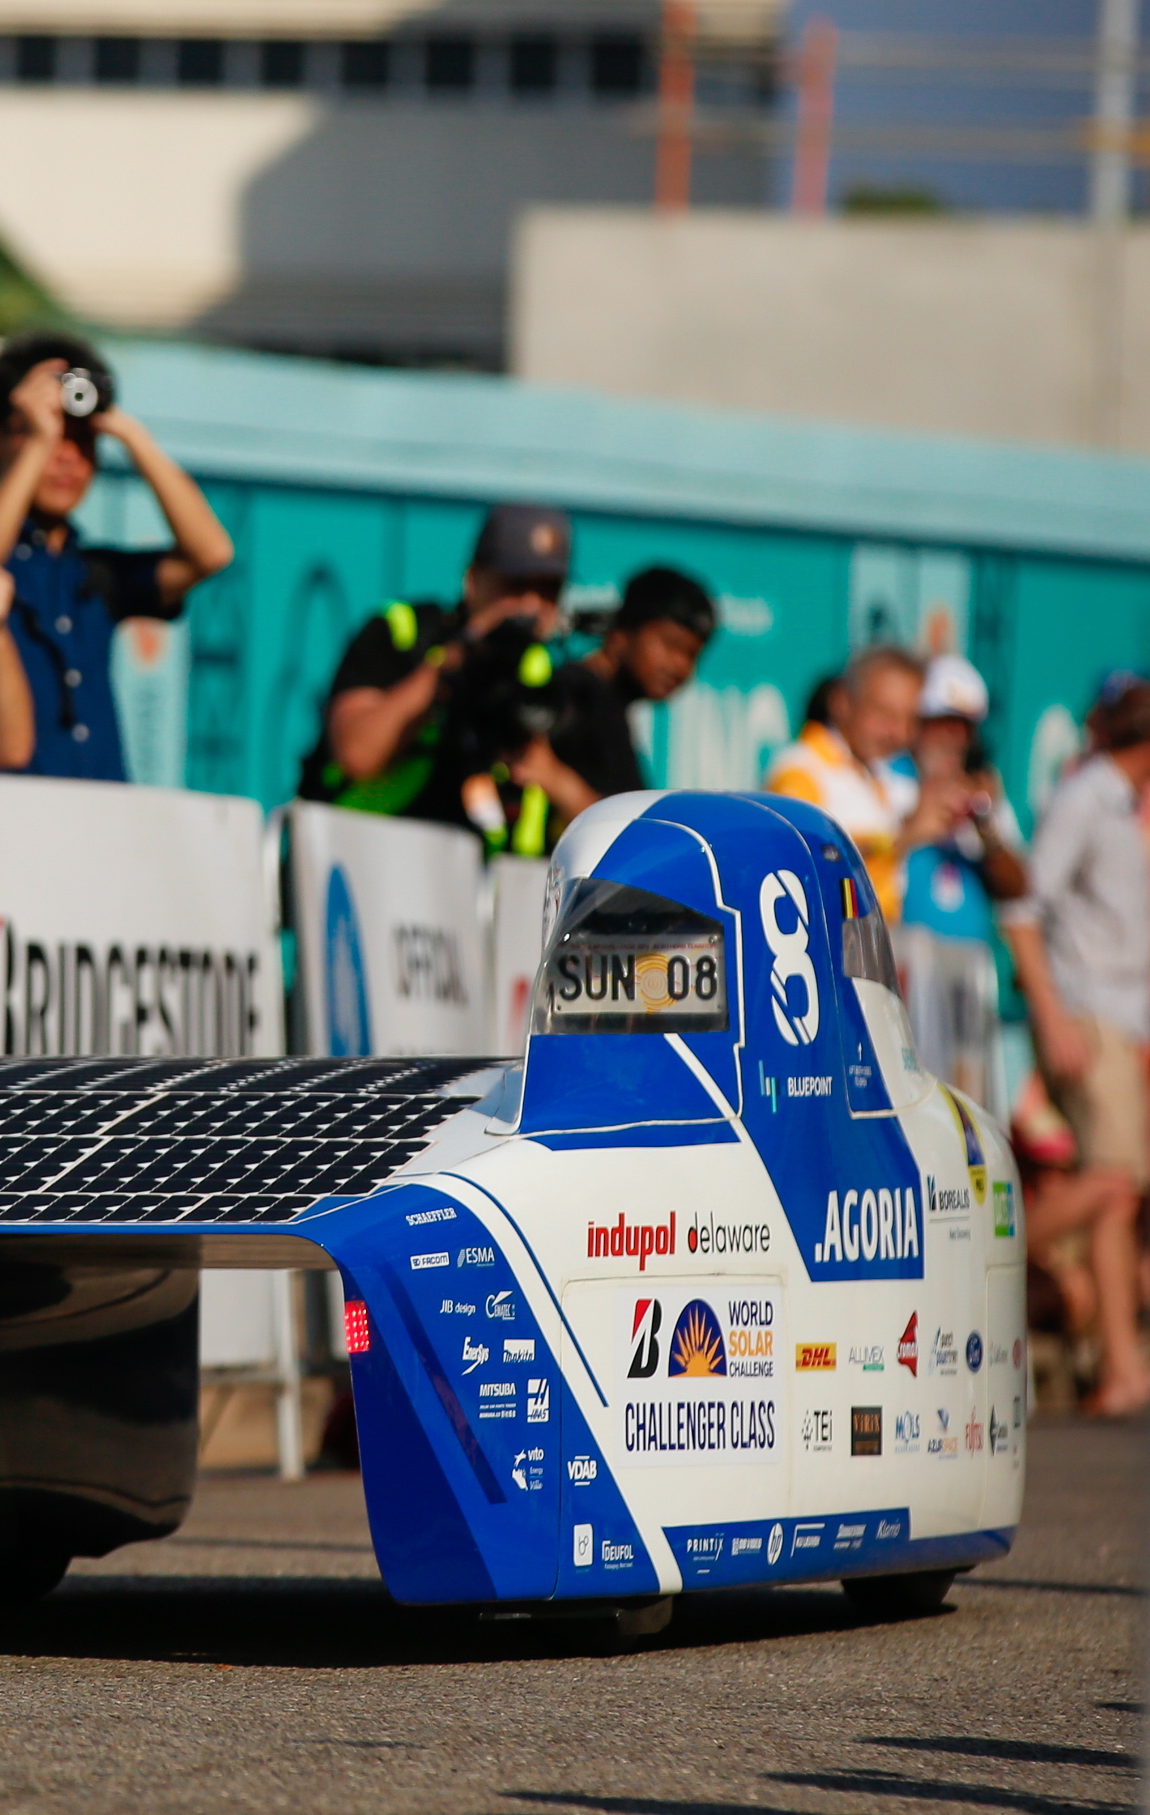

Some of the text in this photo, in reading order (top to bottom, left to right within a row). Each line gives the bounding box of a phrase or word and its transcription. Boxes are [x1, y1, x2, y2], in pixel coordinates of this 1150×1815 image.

[759, 869, 821, 1046] 8
[557, 953, 718, 1002] SUN 08
[787, 1075, 833, 1098] BLUEPOINT
[939, 1188, 971, 1211] BOREALIS
[405, 1207, 457, 1227] SCHAEFFLER
[587, 1211, 677, 1271] indupol
[687, 1211, 771, 1254] delaware
[465, 1247, 496, 1264] ESMA
[440, 1299, 477, 1317] JIB design
[728, 1300, 774, 1326] WORLD
[728, 1330, 774, 1357] SOLAR
[801, 1346, 832, 1368] DHL
[729, 1361, 774, 1378] CHALLENGE
[479, 1382, 517, 1398] MITSUBA
[625, 1400, 776, 1451] CHALLENGER CLASS
[527, 1446, 545, 1461] vito
[567, 1460, 598, 1480] VDAB
[603, 1544, 635, 1561] DEUFOL
